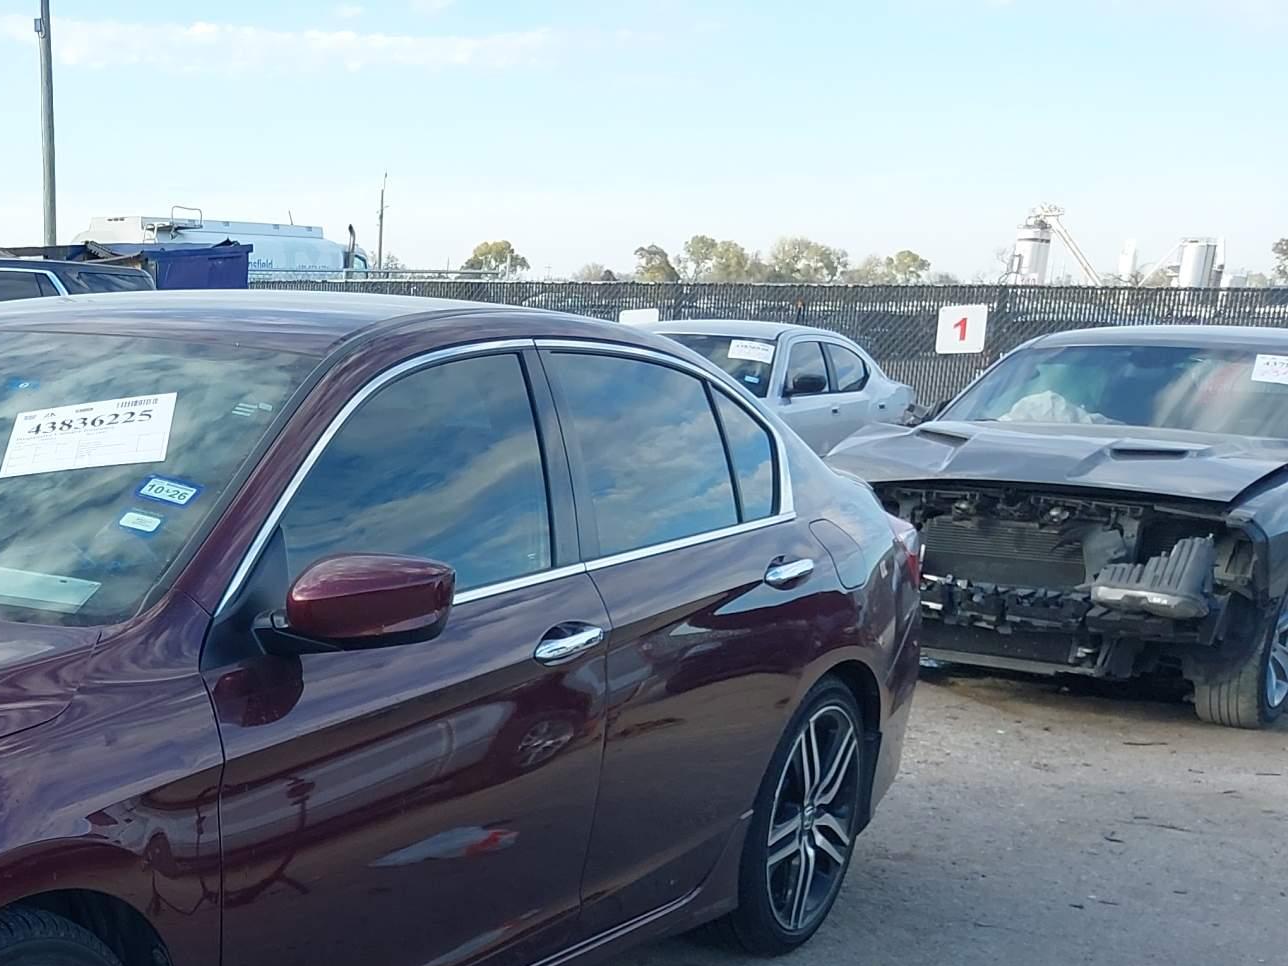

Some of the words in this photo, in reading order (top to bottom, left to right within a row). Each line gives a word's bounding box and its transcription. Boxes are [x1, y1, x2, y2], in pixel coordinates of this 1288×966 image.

[953, 317, 968, 341] 1
[27, 409, 153, 435] 43836225
[148, 484, 165, 495] 10
[168, 490, 188, 501] 26
